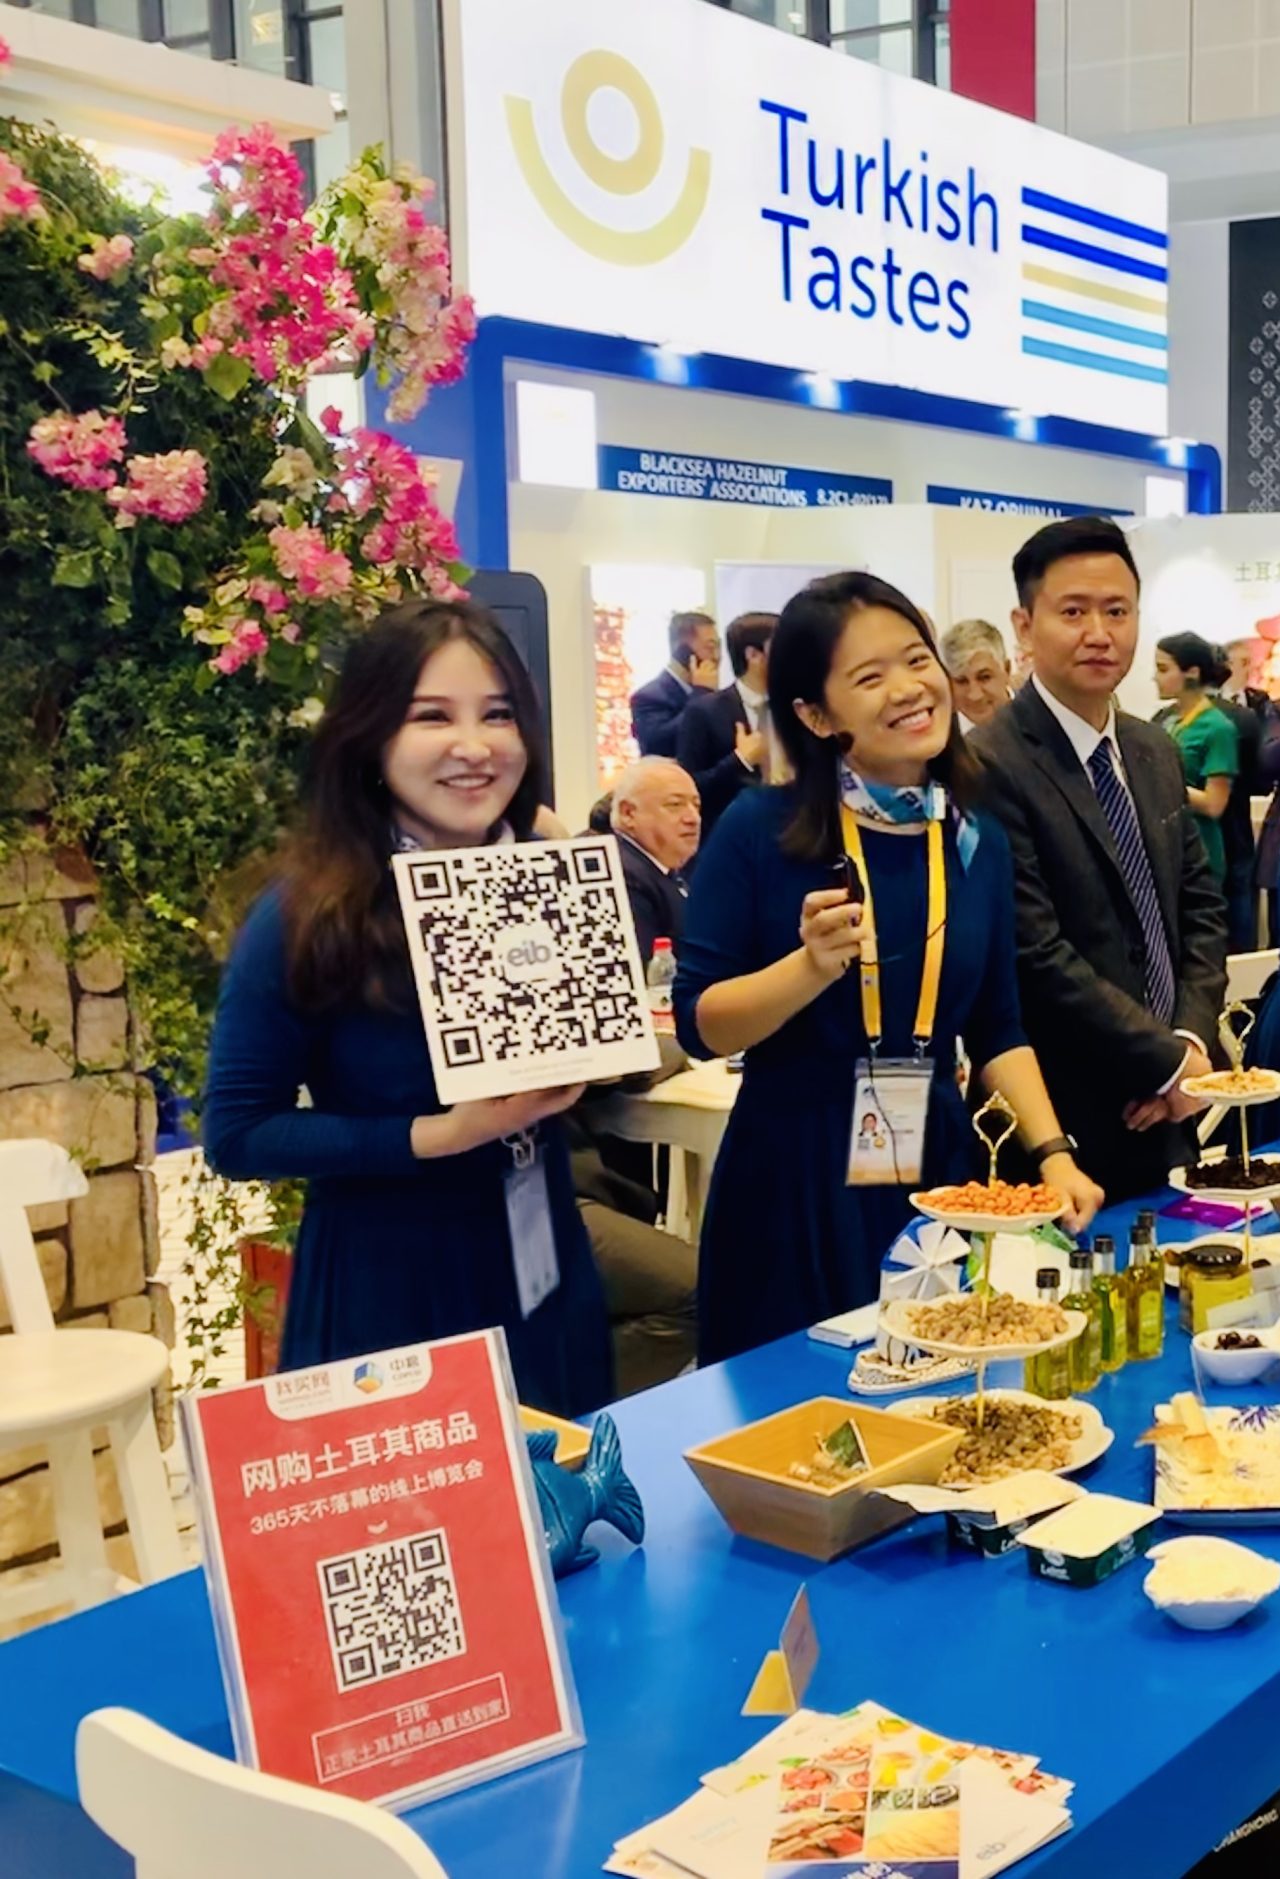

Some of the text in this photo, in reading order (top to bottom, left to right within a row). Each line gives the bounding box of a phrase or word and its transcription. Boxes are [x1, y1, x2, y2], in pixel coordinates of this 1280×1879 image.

[759, 98, 999, 252] Turkish
[761, 207, 971, 339] Tastes
[617, 471, 707, 496] EXPORTERS'
[710, 480, 807, 507] ASSOCIATIONS
[640, 453, 788, 486] BLACKSEA HAZELNUT
[507, 941, 551, 967] eib
[240, 1411, 478, 1499] 网购土耳其商品
[250, 1458, 485, 1536] 365天不落幕的线上博览会
